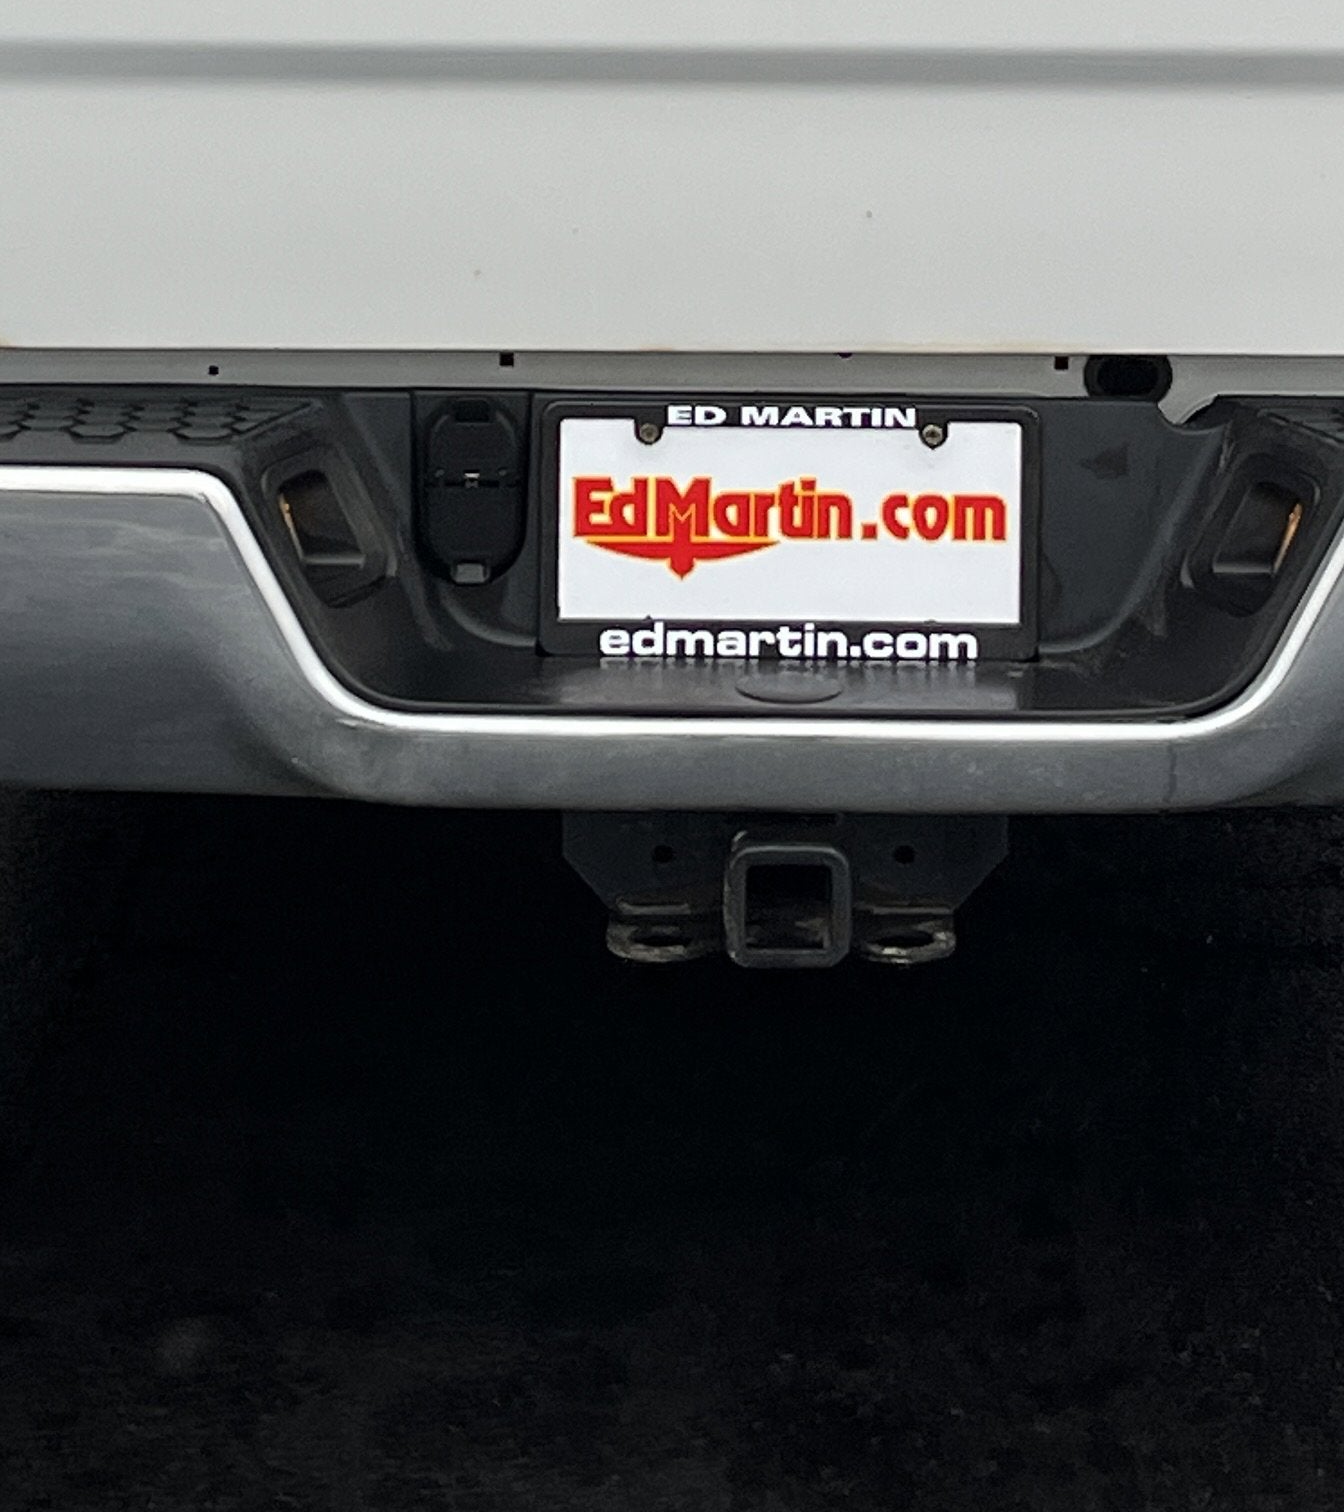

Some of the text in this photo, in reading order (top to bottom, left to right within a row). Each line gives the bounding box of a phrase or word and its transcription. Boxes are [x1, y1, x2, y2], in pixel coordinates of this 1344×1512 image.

[666, 404, 917, 428] ED MARTIN
[599, 621, 978, 659] edmartin.com
